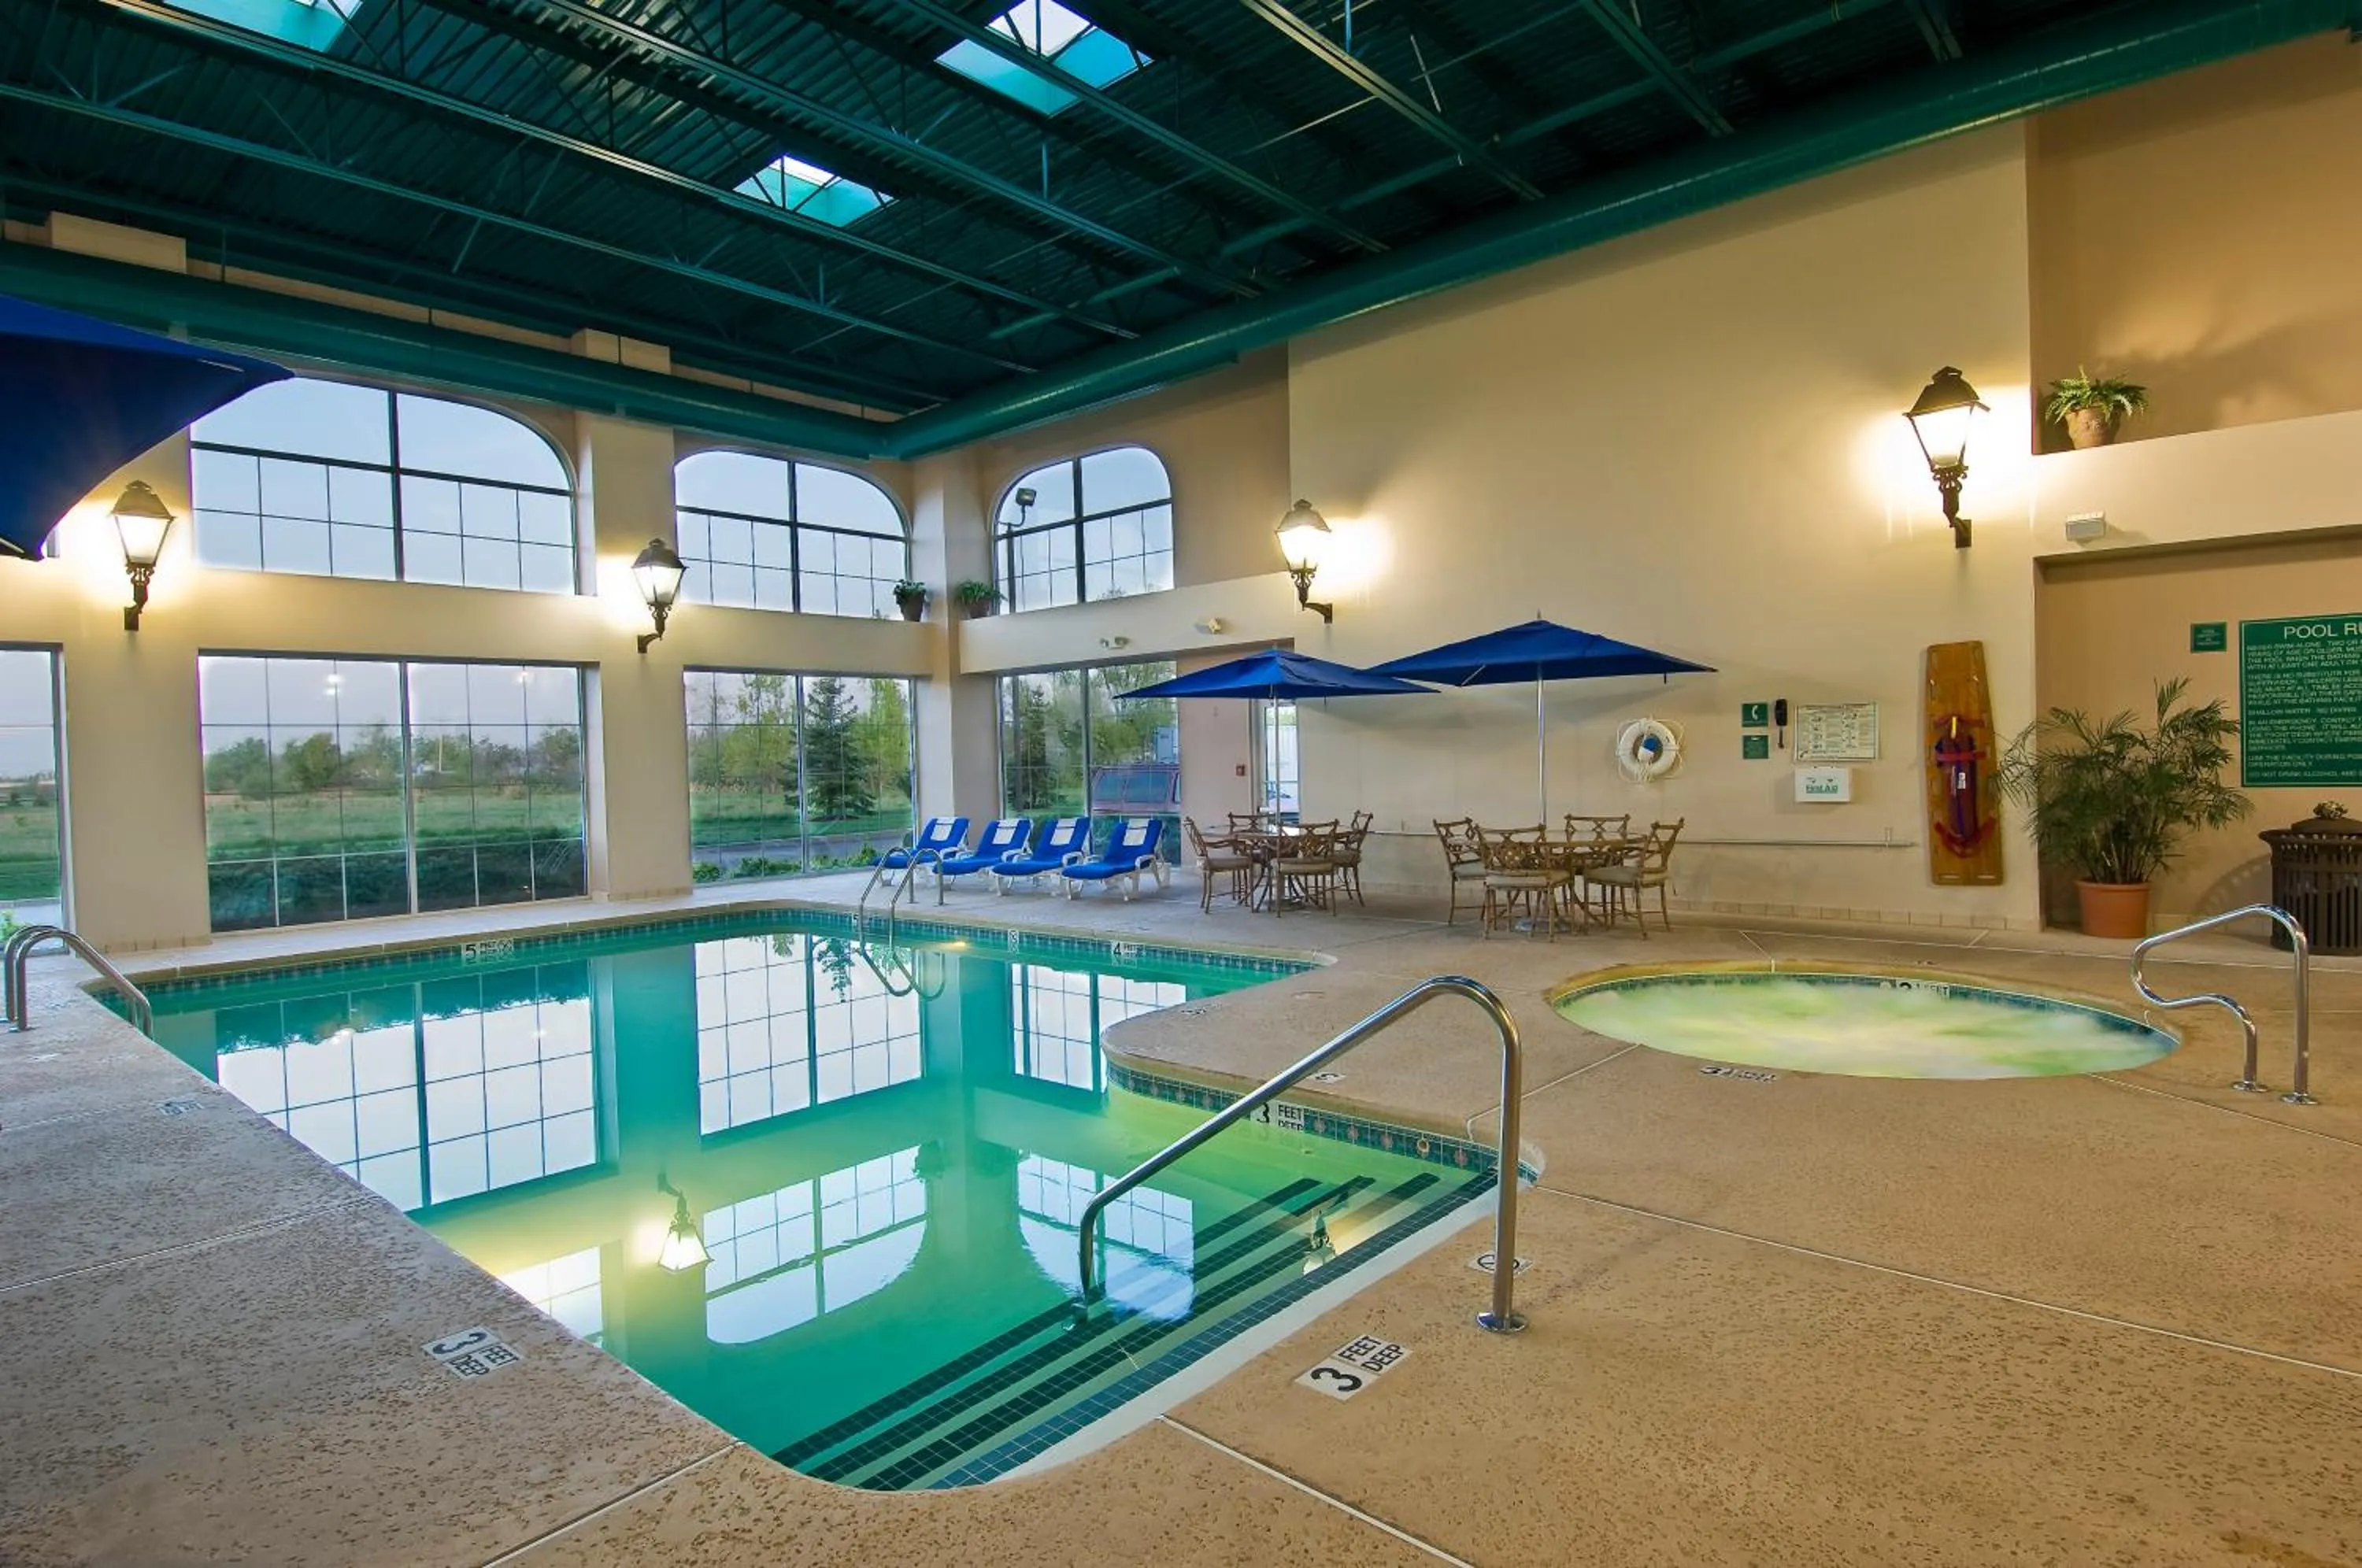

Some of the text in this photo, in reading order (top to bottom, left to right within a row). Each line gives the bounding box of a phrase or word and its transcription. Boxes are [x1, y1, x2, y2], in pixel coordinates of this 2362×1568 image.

[2283, 624, 2338, 639] POOL
[1257, 1102, 1270, 1124] 3
[1278, 1104, 1302, 1120] FEET
[433, 1332, 487, 1355] 3
[1338, 1335, 1382, 1363] FEET
[449, 1355, 491, 1378] DEEP
[479, 1345, 520, 1367] FEET
[1361, 1344, 1404, 1372] DEEP
[1310, 1366, 1363, 1392] 3
